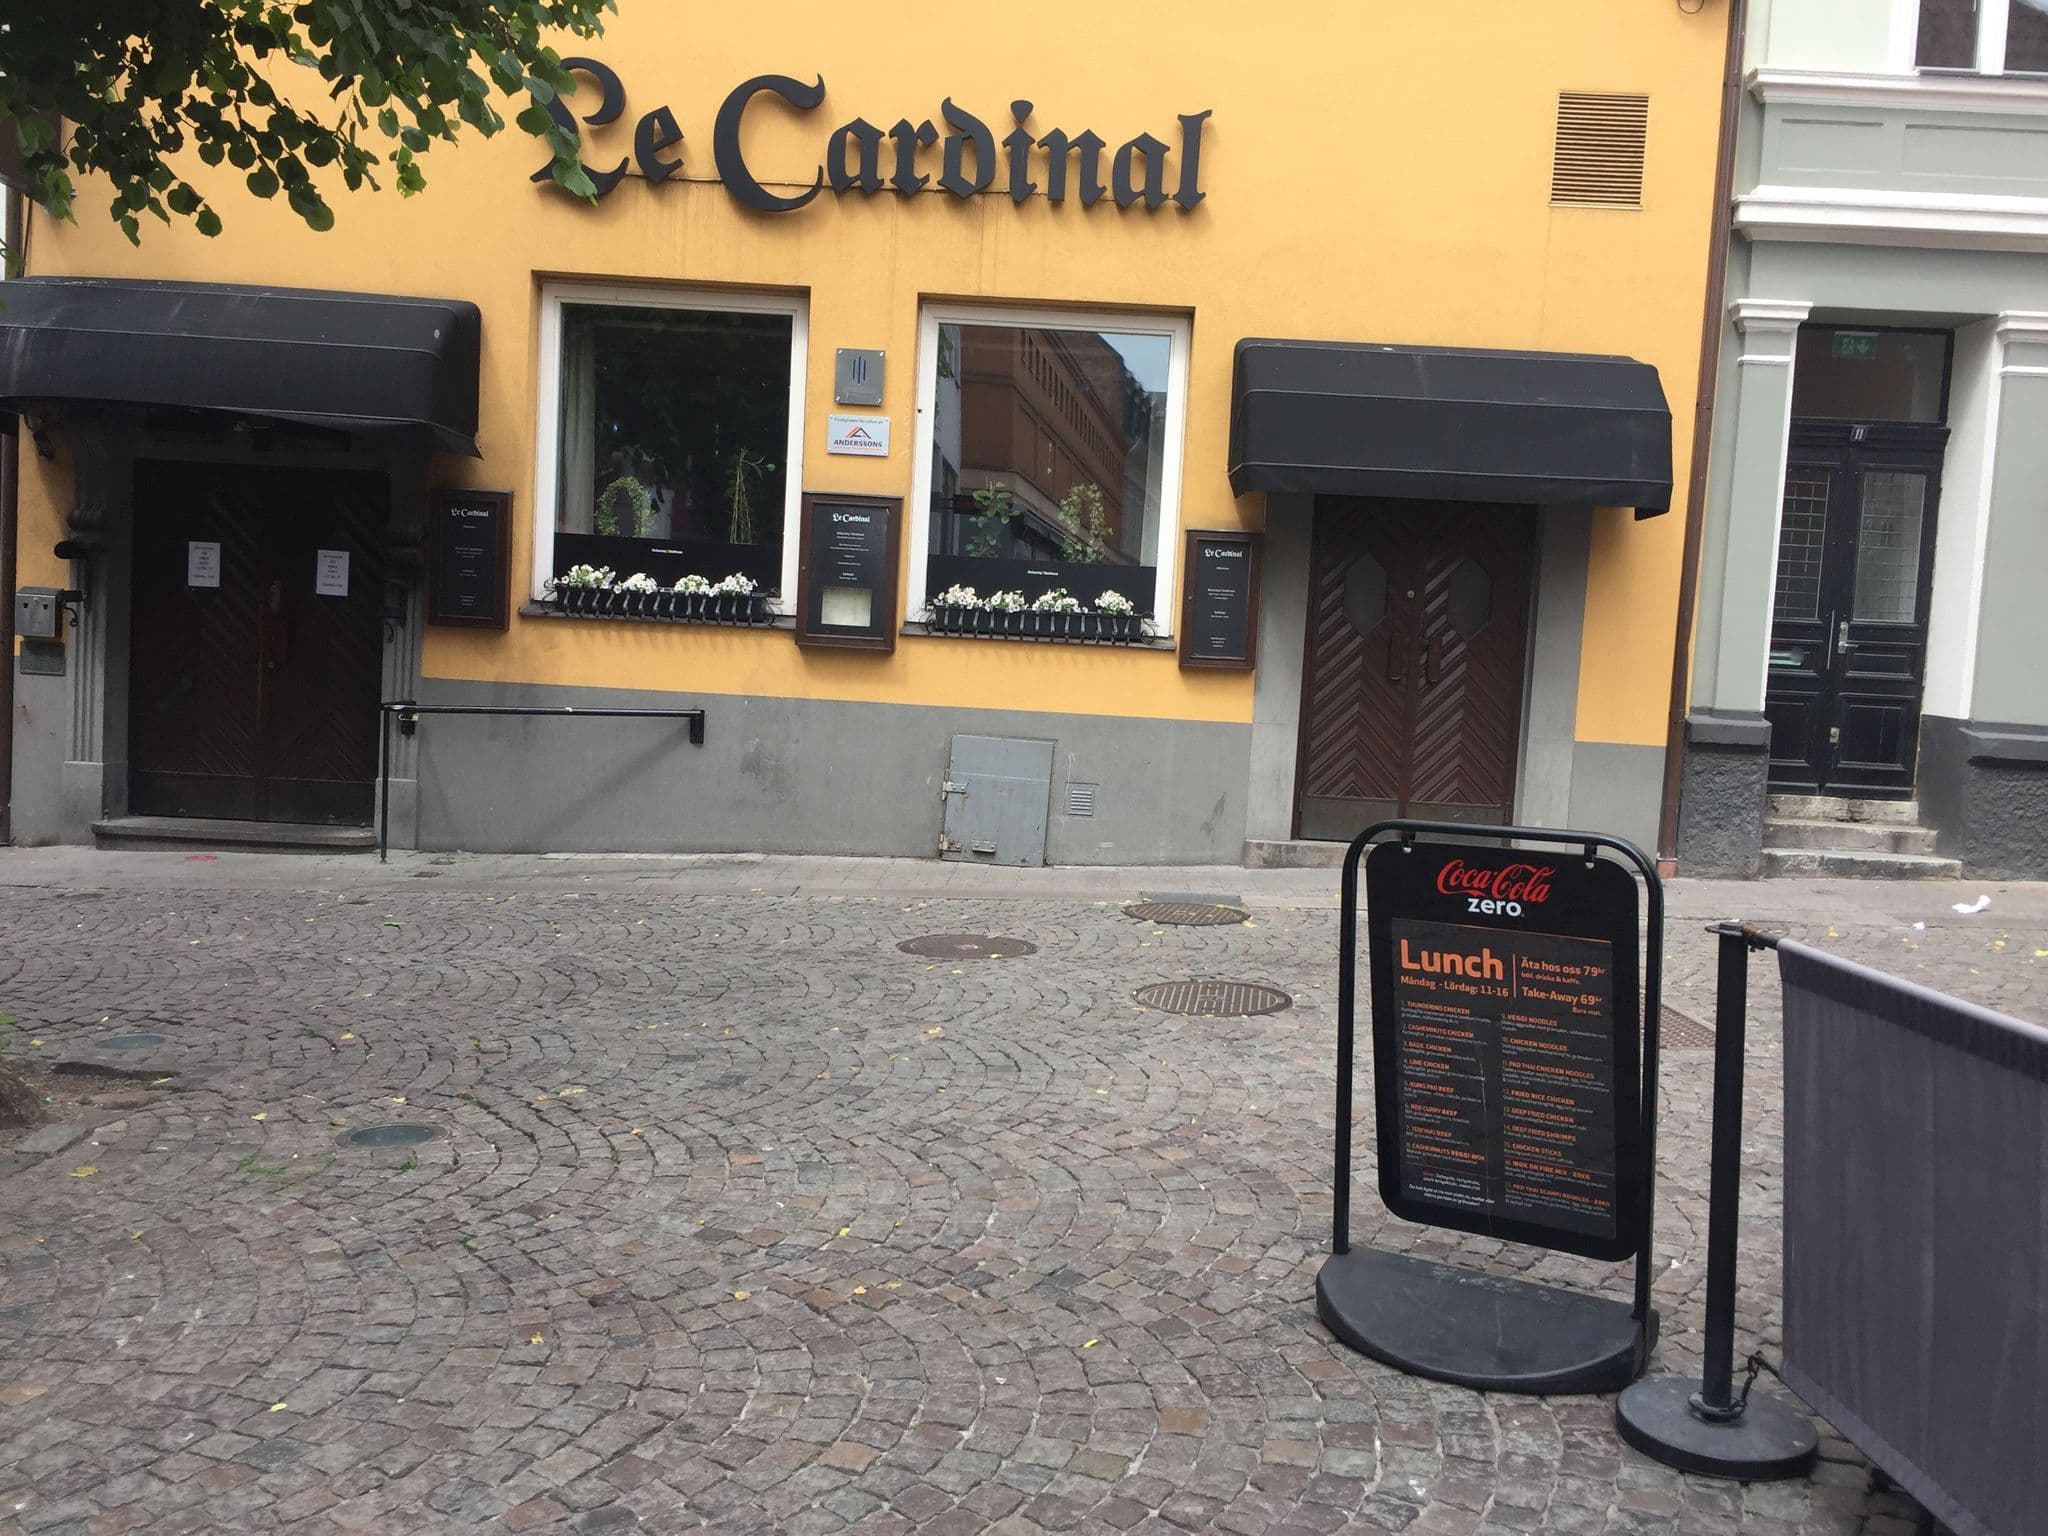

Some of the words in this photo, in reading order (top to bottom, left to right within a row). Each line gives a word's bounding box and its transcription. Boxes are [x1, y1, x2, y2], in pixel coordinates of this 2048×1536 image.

[530, 57, 685, 197] Le
[713, 73, 1213, 213] Cardinal
[833, 439, 883, 447] ANDERSSONS
[461, 508, 489, 517] Cardinal
[832, 513, 842, 522] Le
[843, 514, 871, 523] Cardinal
[1204, 548, 1214, 557] Le
[1215, 549, 1243, 558] Cardinal
[1436, 859, 1557, 903] Coca-Cola
[1467, 898, 1522, 917] zero
[1400, 939, 1504, 980] Lunch
[1521, 956, 1540, 970] Äta
[1541, 961, 1561, 972] hos
[1562, 966, 1581, 975] oss
[1401, 976, 1437, 990] Måndag
[1444, 981, 1479, 995] Lördag:
[1480, 985, 1509, 997] 11-16
[1521, 986, 1578, 1005] Take-Away
